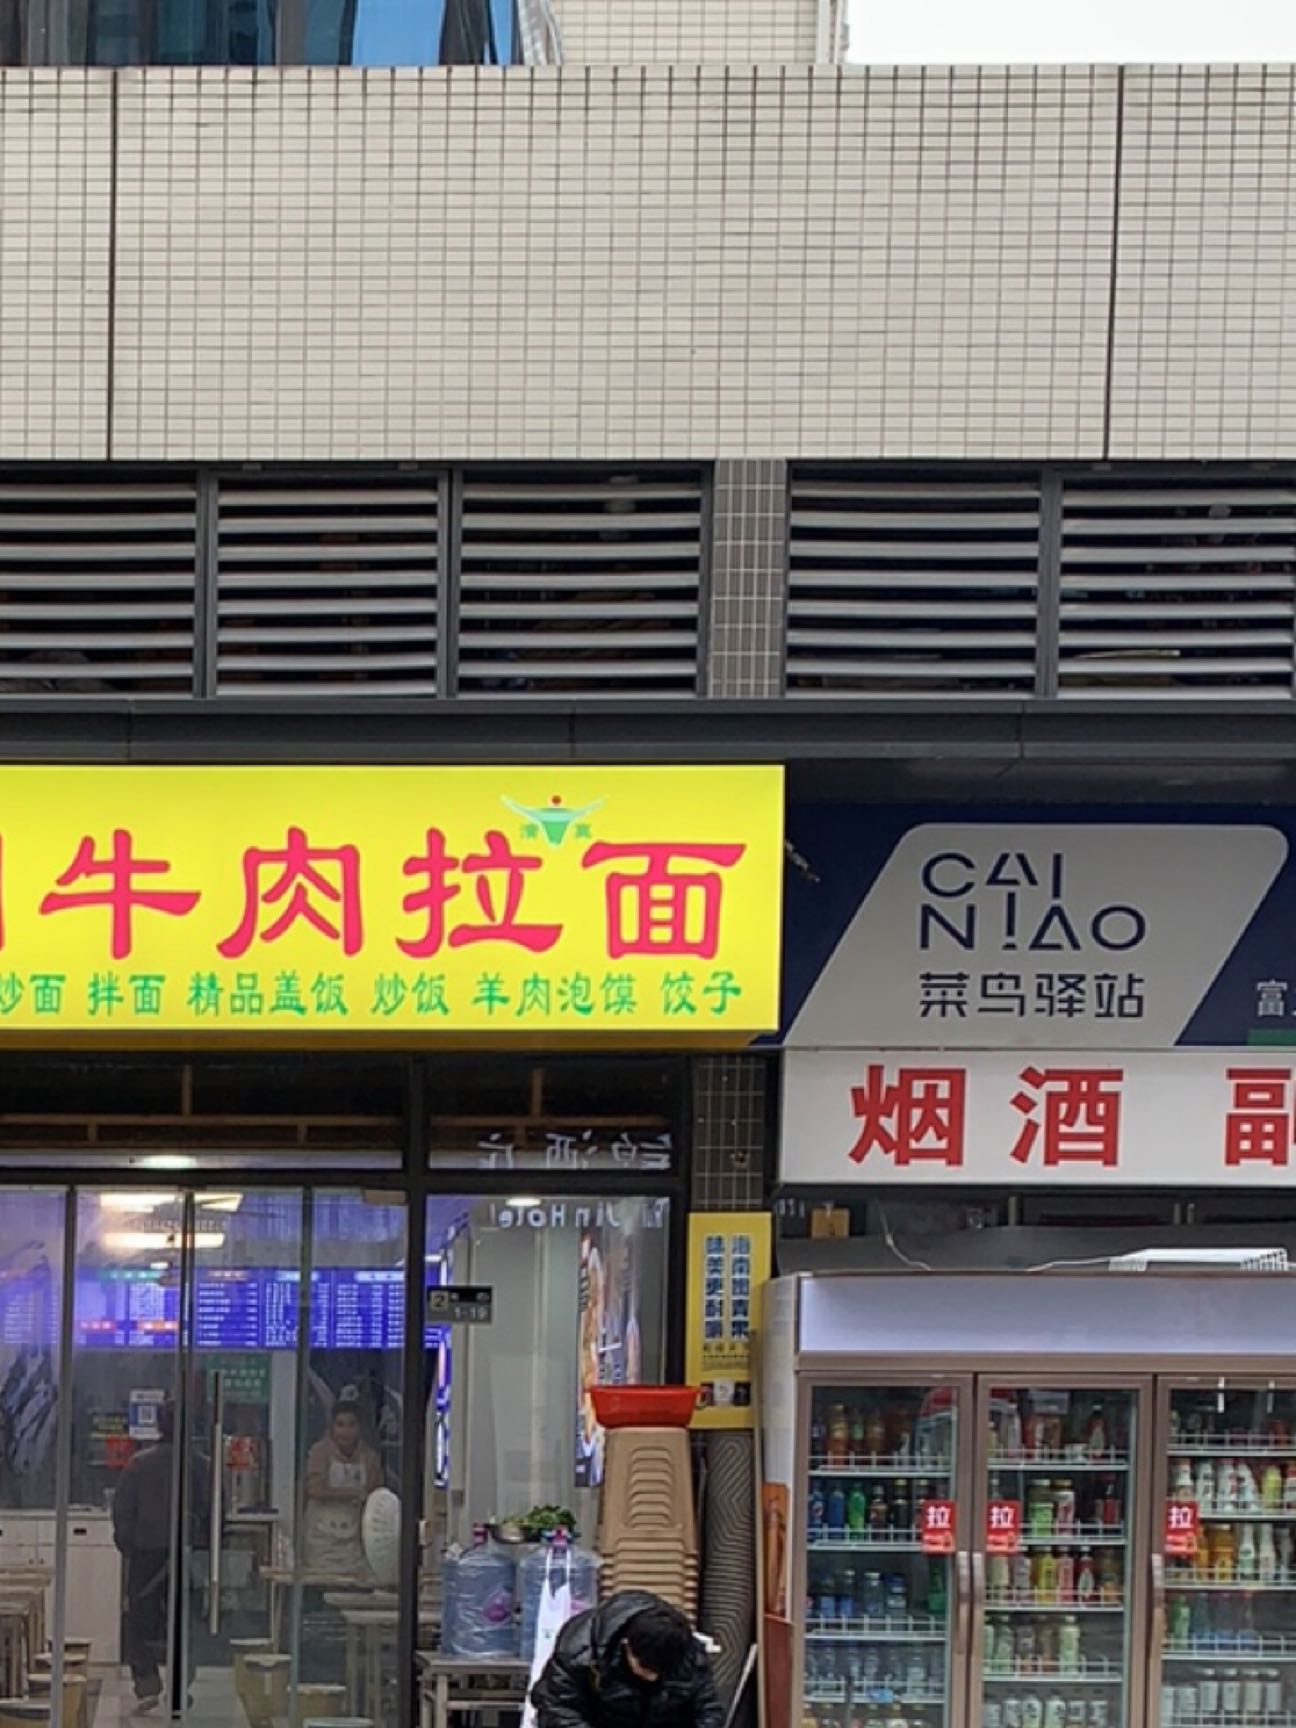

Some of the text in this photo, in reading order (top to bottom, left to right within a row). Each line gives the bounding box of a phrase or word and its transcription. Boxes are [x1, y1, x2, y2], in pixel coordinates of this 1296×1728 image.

[920, 852, 1063, 899] CAI
[86, 970, 166, 1016] 拌面
[186, 970, 349, 1017] 精品盖饭
[371, 971, 450, 1016] 炒饭
[472, 971, 638, 1017] 羊肉泡馍
[660, 970, 743, 1016] 饺子
[919, 972, 1145, 1018] 菜鸟驿站
[1256, 978, 1296, 1017] 富
[926, 1505, 951, 1529] 拉
[990, 1505, 1015, 1529] 拉
[1169, 1505, 1194, 1529] 拉
